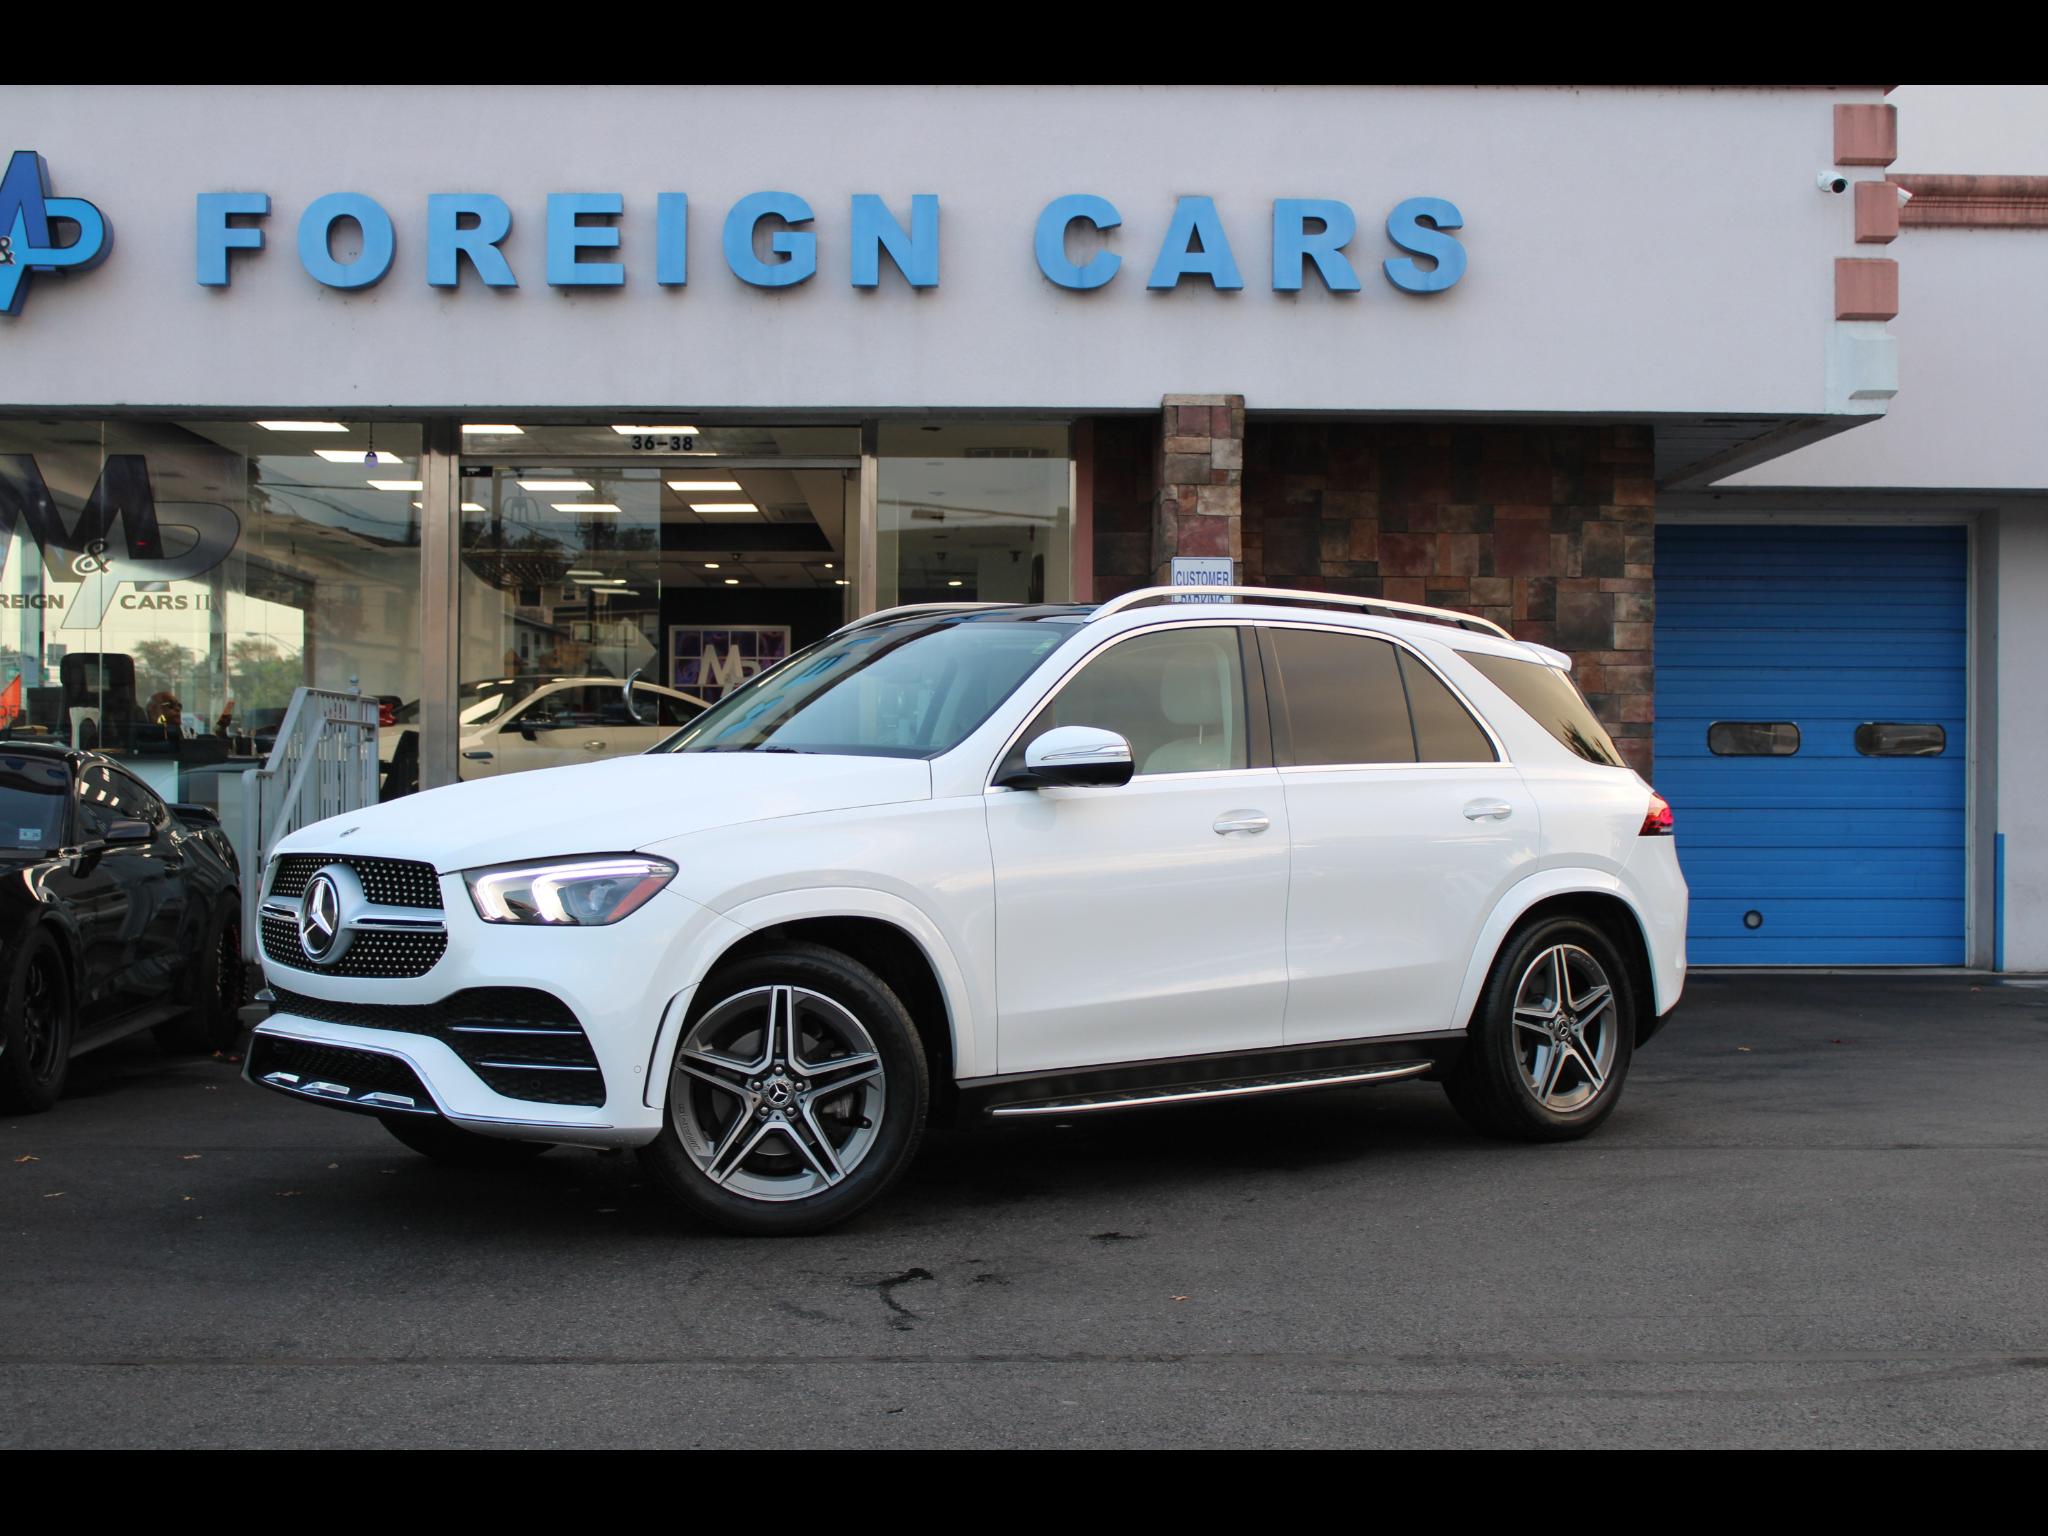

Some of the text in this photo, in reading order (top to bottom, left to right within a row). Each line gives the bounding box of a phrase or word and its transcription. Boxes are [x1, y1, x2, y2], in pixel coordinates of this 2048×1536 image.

[196, 191, 1468, 295] FOREIGN CARS
[631, 435, 693, 451] 36-38
[1175, 570, 1229, 587] CUSTOMER
[119, 594, 188, 610] CARS
